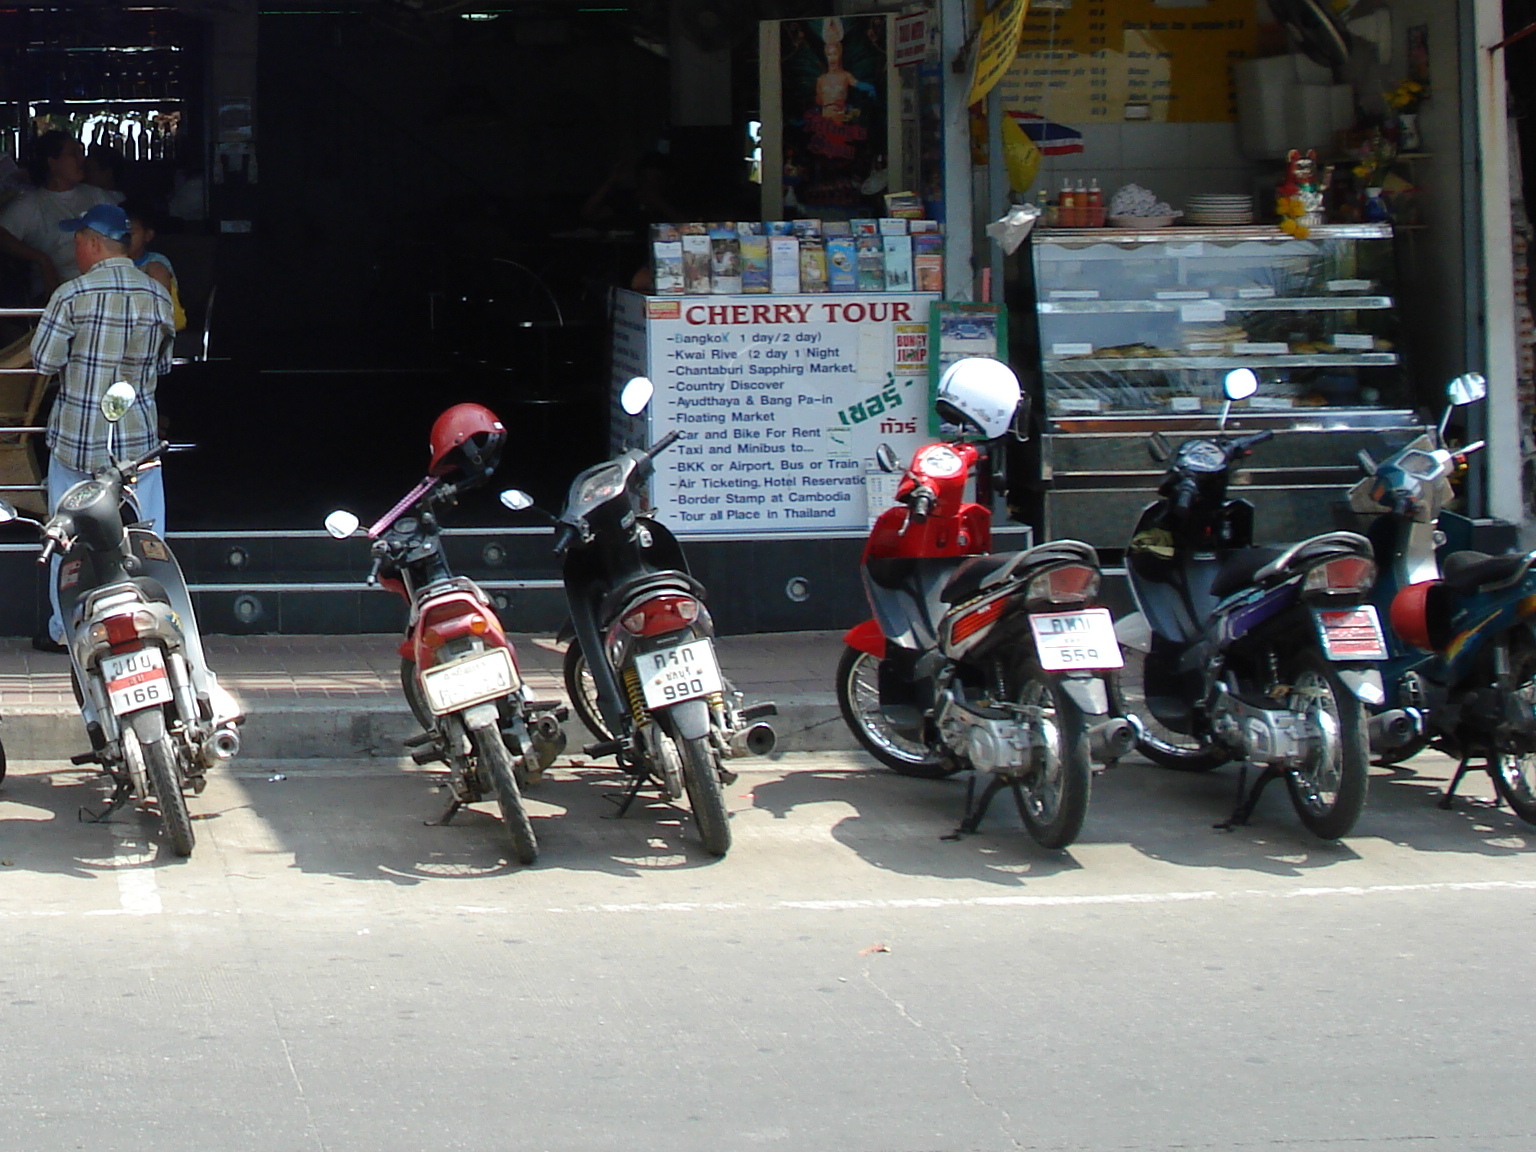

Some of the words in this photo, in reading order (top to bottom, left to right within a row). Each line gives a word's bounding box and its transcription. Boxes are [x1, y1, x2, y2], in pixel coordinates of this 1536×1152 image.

[685, 303, 814, 326] CHERRY
[822, 301, 913, 323] TOUR
[740, 334, 746, 342] 1
[795, 332, 822, 343] day)
[711, 349, 738, 360] Rive
[766, 349, 788, 360] day
[806, 348, 840, 360] Night
[730, 380, 785, 390] Discover
[746, 395, 755, 406] &
[761, 395, 792, 407] Bang
[798, 394, 833, 404] Pa-in
[731, 411, 776, 422] Market
[705, 429, 728, 439] and
[733, 428, 761, 439] Bike
[766, 428, 786, 438] For
[792, 427, 821, 438] Rent
[708, 444, 732, 454] and
[737, 443, 786, 453] Minibus
[710, 463, 724, 472] or
[780, 460, 804, 470] Bus
[809, 461, 823, 469] or
[827, 459, 859, 469] Train
[764, 477, 796, 487] Hotel
[726, 493, 766, 505] Stamp
[770, 494, 783, 503] at
[788, 492, 851, 503] Cambodia
[710, 510, 723, 521] all
[727, 509, 761, 521] Place
[767, 509, 778, 519] in
[784, 507, 836, 519] Thailand
[1060, 649, 1099, 663] 559
[122, 685, 160, 707] 166
[663, 678, 704, 701] 990
